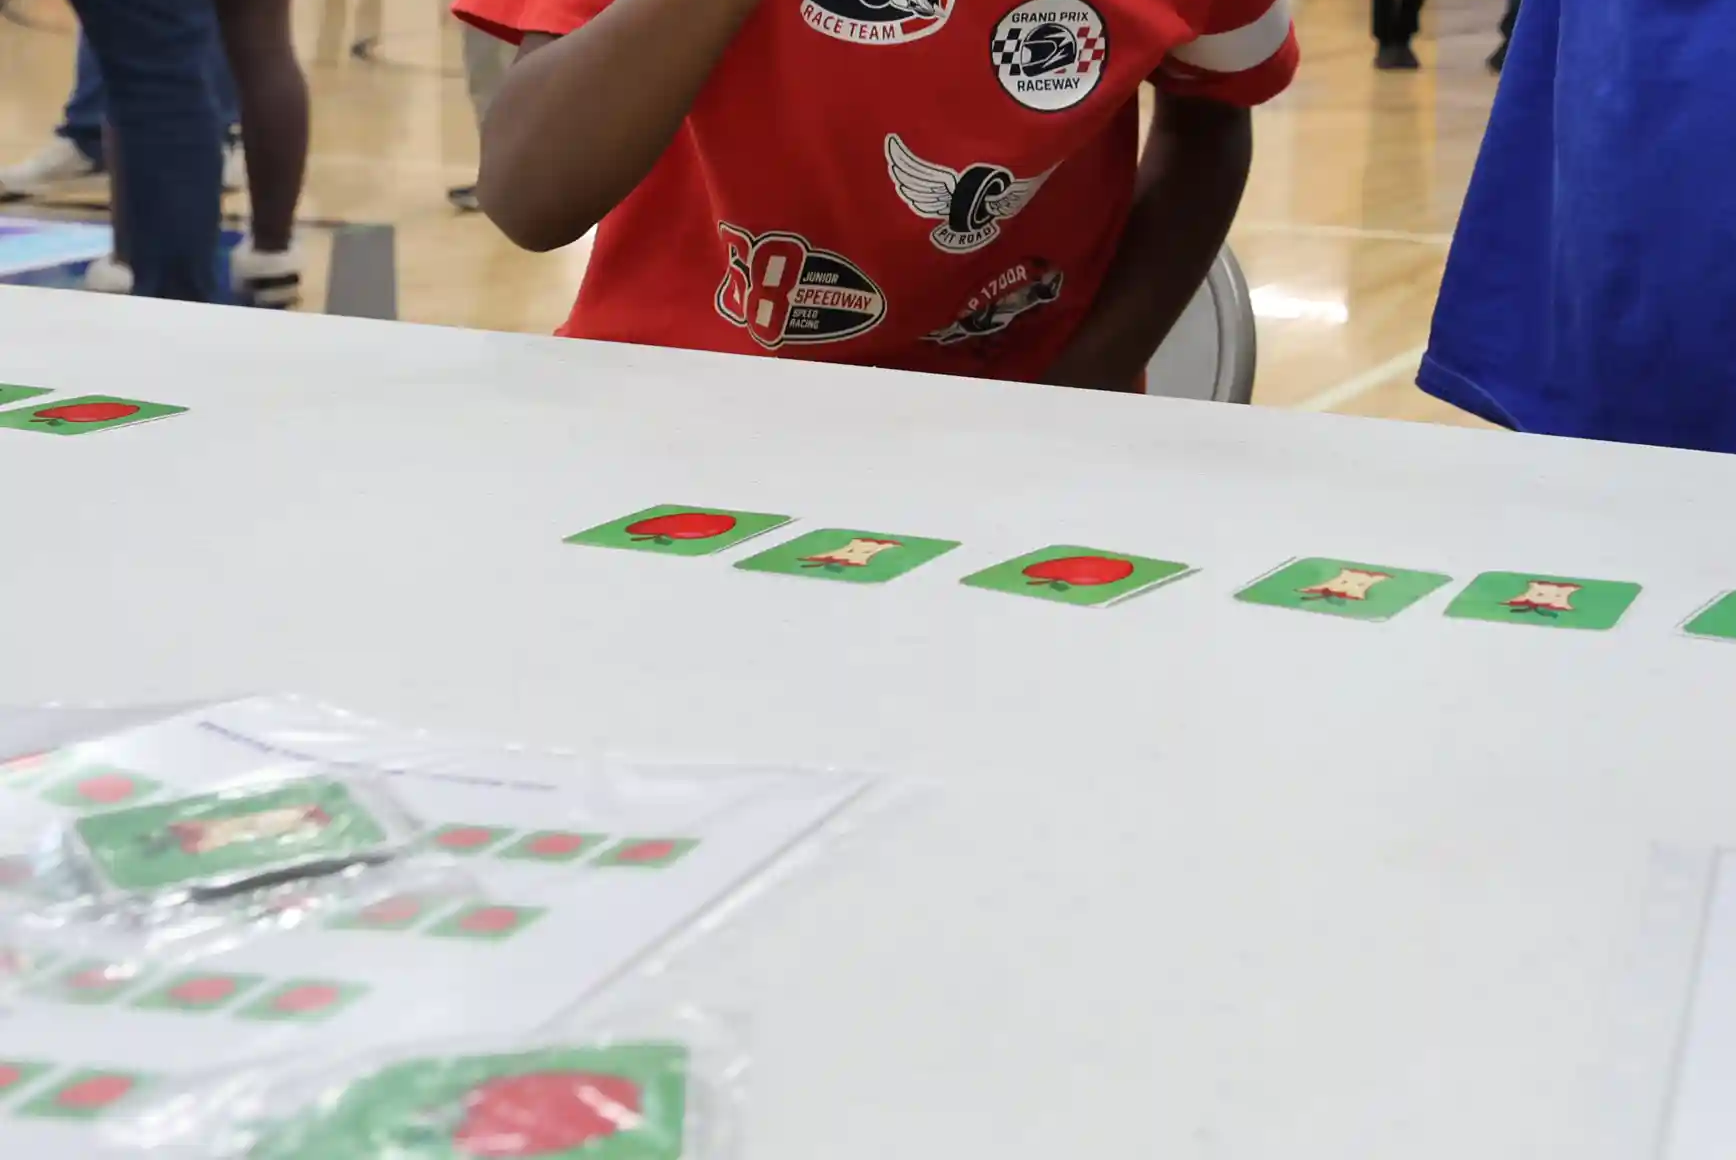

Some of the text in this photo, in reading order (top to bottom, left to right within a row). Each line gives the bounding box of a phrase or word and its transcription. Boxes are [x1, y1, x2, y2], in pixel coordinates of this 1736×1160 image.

[803, 4, 896, 41] RACE TEAM
[1011, 11, 1089, 23] GRAND PRIX
[1017, 77, 1081, 92] RACEWAY
[938, 225, 992, 245] PIT ROAD
[803, 271, 839, 284] JUNIOR
[794, 289, 872, 311] SPEEDWAY
[789, 318, 820, 330] RACING
